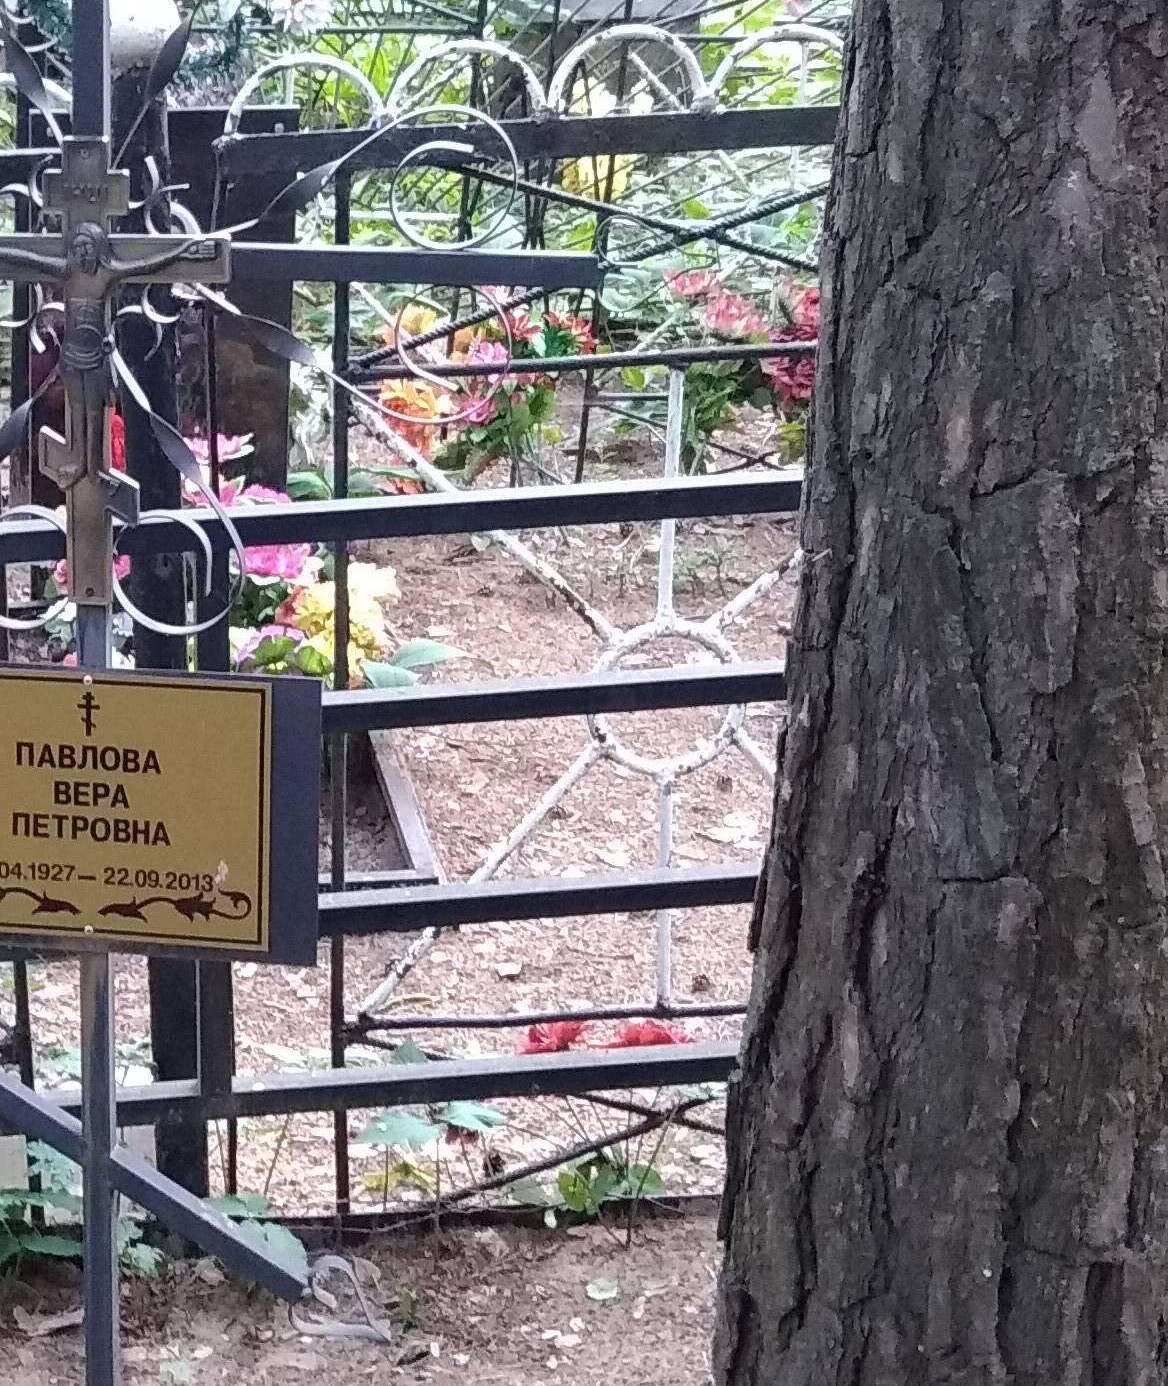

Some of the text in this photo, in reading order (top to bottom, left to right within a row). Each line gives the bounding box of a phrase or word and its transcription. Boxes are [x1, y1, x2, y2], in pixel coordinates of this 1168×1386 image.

[15, 741, 162, 774] ПАВЛОВА
[53, 780, 130, 809] ВЕРА
[11, 812, 171, 846] ПЕТРОВНА
[103, 866, 214, 893] 22.09.2013
